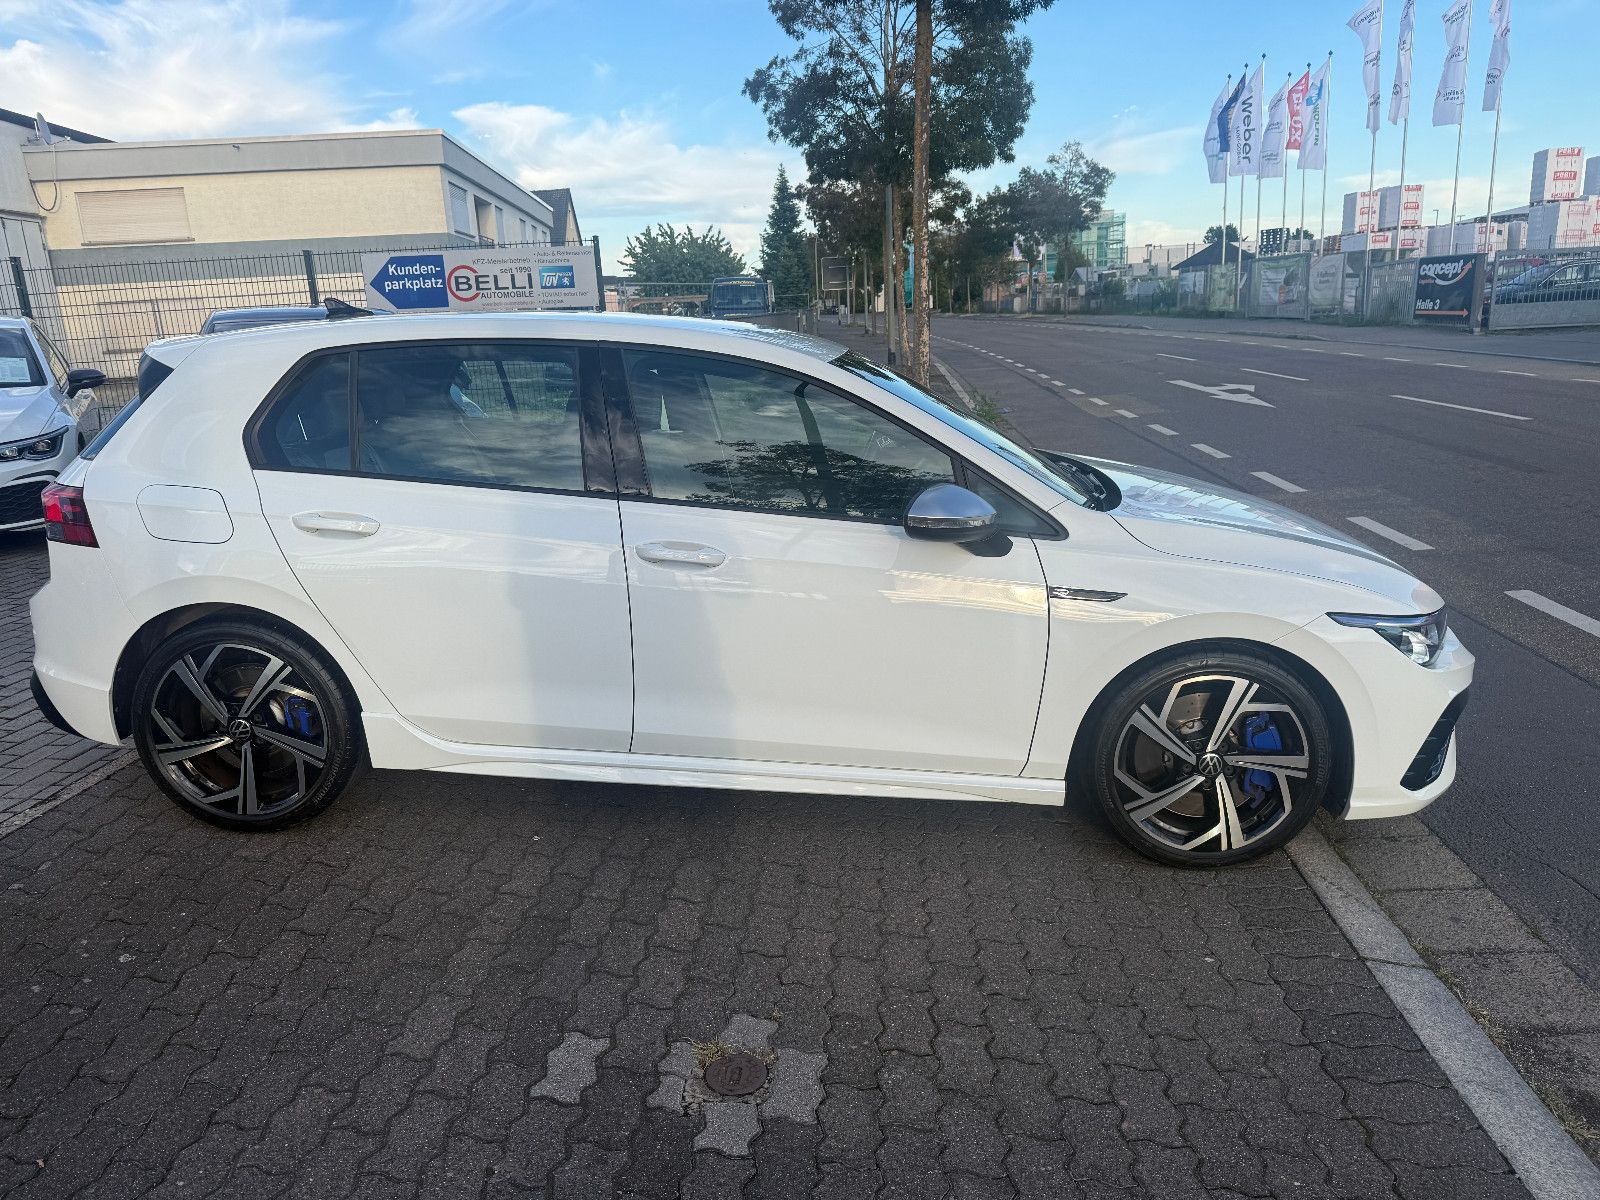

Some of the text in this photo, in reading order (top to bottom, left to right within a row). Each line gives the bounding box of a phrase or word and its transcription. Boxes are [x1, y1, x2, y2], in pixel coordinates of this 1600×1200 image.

[1241, 95, 1255, 164] weber
[1312, 103, 1321, 146] WOLFIN
[388, 263, 441, 276] Kunden-
[1420, 260, 1464, 278] concept
[384, 277, 444, 292] parkplatz
[454, 273, 534, 292] BELLI
[480, 290, 534, 299] AUTOMOBILE
[1416, 299, 1441, 310] Halle 3
